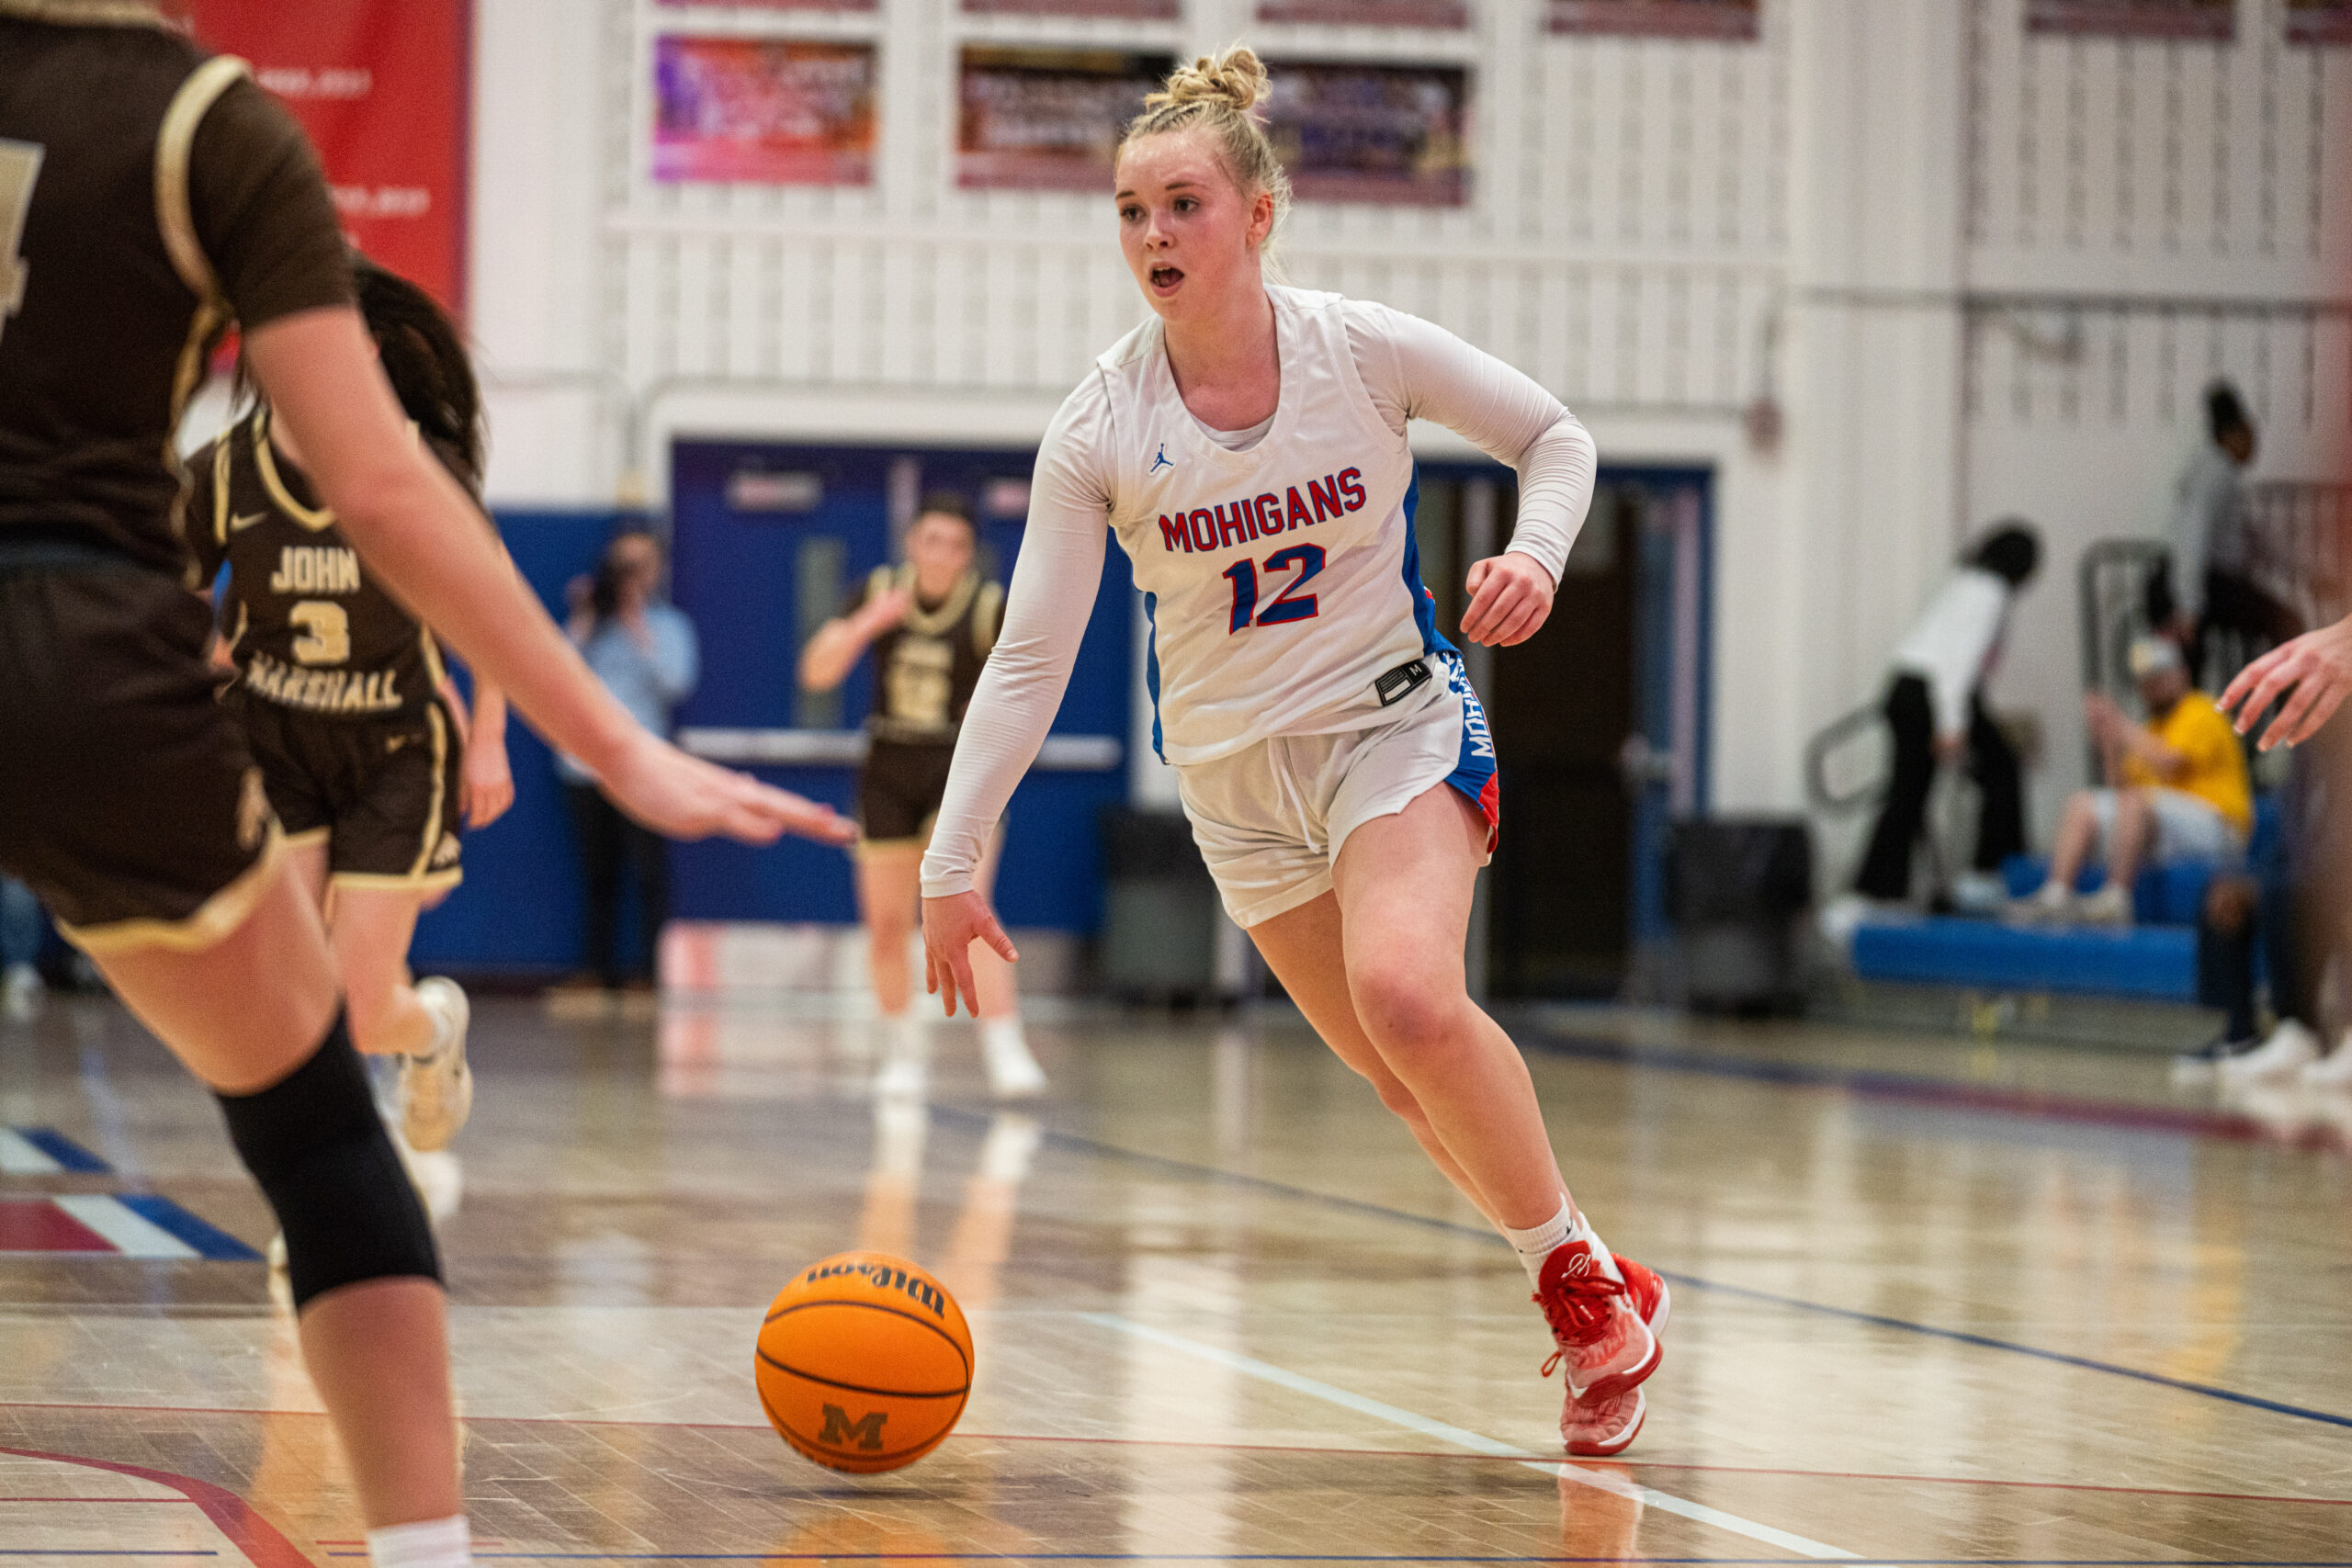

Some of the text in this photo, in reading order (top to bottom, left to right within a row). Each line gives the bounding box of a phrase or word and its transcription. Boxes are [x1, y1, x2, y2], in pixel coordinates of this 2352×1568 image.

[1159, 466, 1367, 553] MOHIGANS
[270, 546, 361, 592] JOHN
[1222, 542, 1327, 636] 12
[289, 600, 351, 665] 3
[246, 649, 402, 711] MARSHALL
[1408, 663, 1423, 676] M
[806, 1262, 945, 1319] Wilson
[819, 1404, 888, 1451] M
